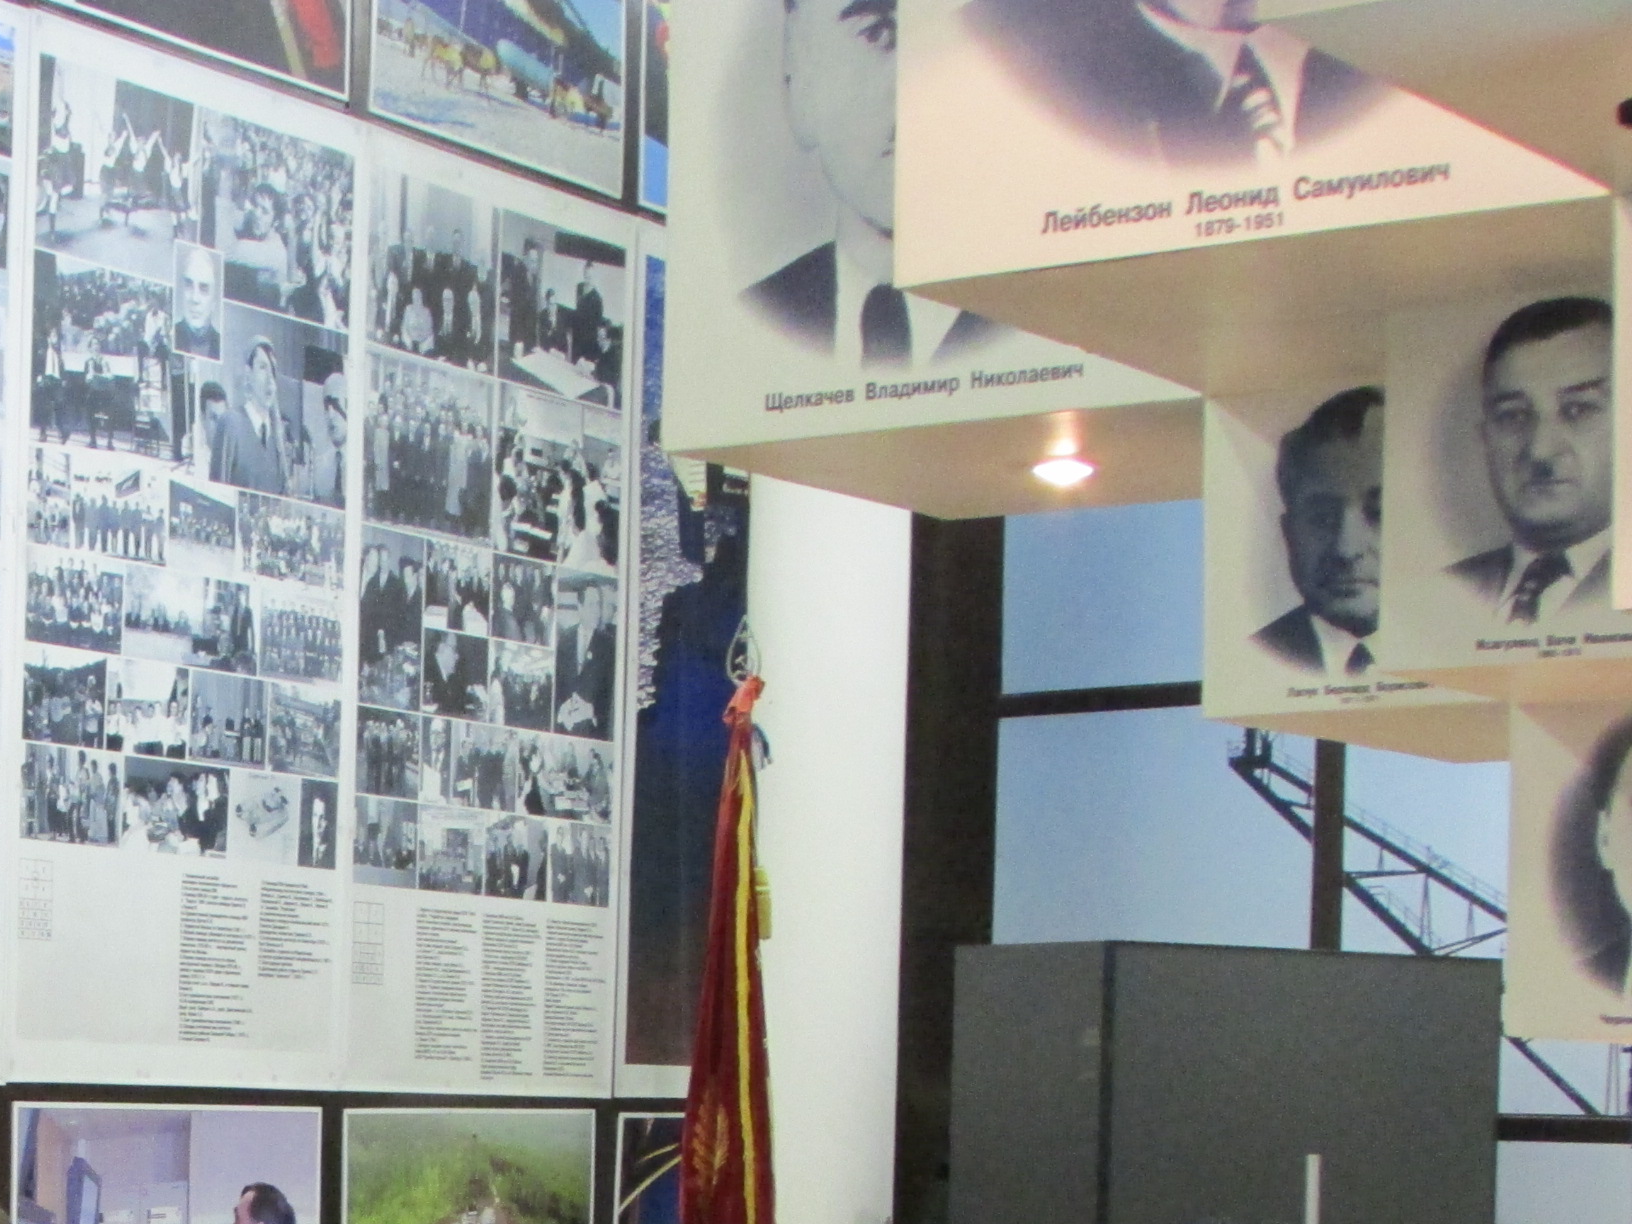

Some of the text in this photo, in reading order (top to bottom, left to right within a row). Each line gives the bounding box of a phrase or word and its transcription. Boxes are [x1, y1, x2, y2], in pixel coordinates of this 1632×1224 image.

[1041, 163, 1451, 234] Лейбензон Леонид Самуилович
[1195, 212, 1285, 237] 1879-1951
[765, 363, 1084, 412] Щелкачев Владимир Николаевич
